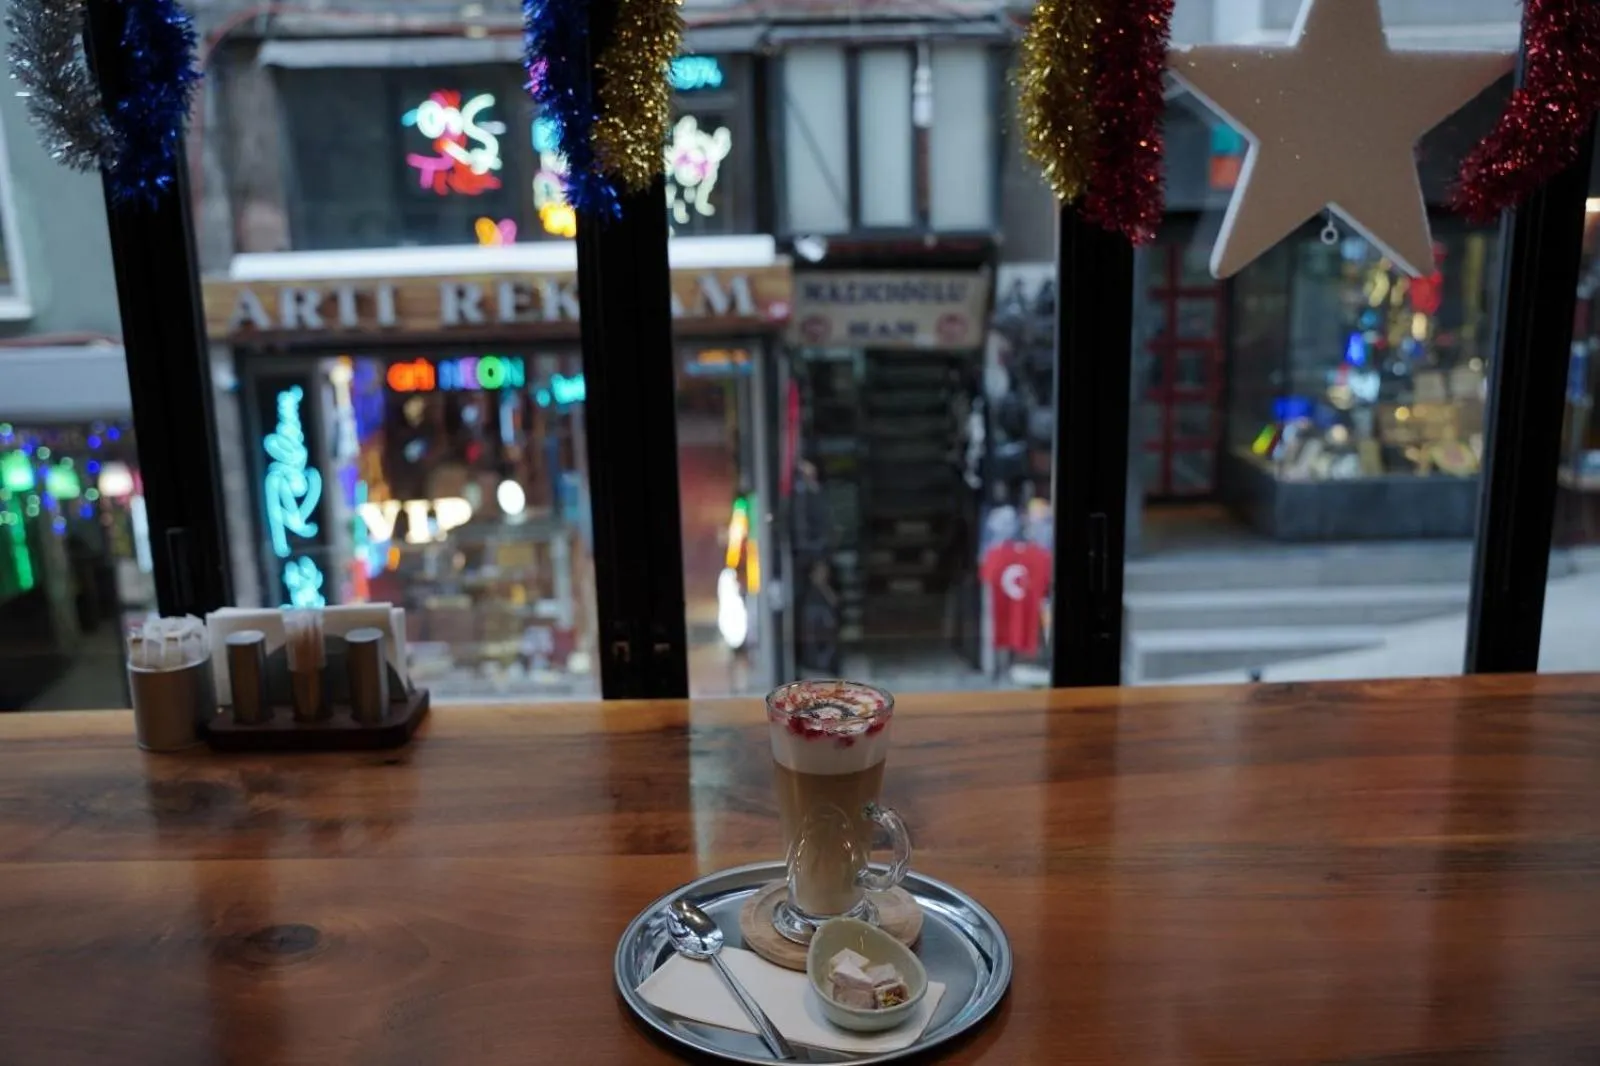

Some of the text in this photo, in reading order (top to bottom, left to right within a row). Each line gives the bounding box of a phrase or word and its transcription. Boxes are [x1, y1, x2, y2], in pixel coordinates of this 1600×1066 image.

[232, 274, 757, 329] ARTI REKM
[358, 497, 472, 543] VIP
